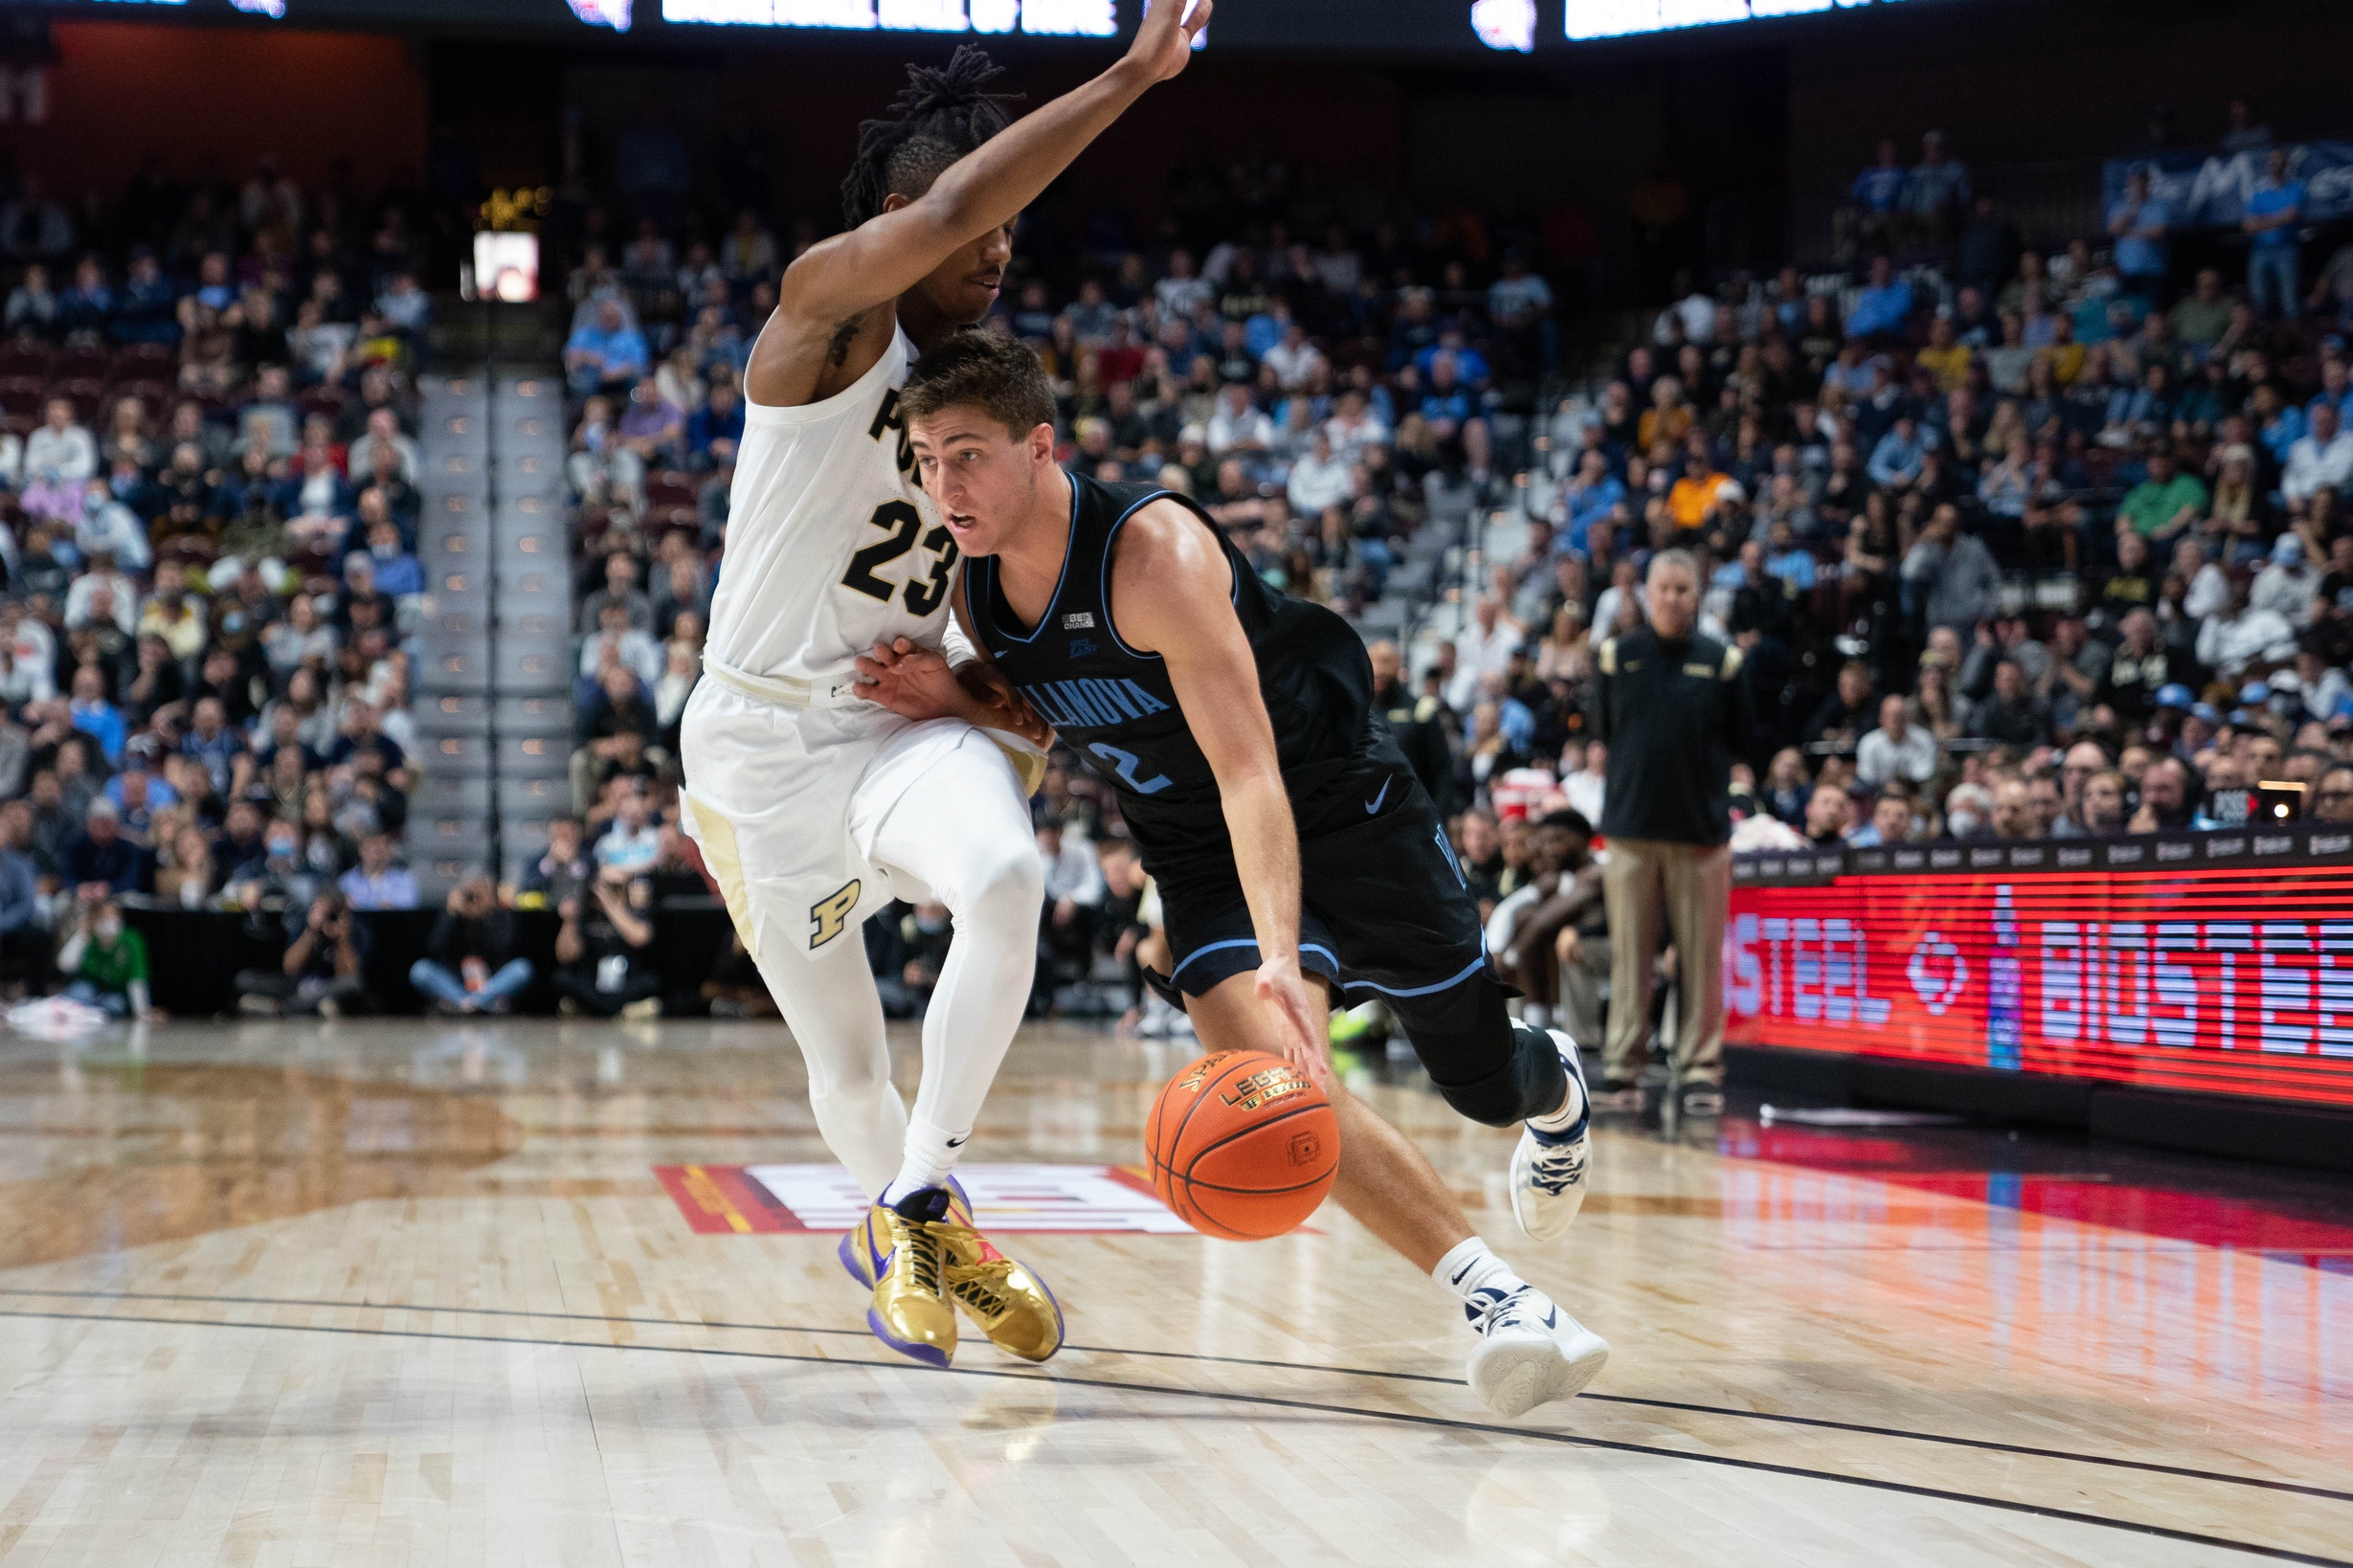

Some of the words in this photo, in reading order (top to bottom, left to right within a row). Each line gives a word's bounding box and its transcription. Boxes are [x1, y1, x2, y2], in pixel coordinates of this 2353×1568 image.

[840, 497, 958, 617] 23
[1087, 742, 1174, 794] 2
[809, 878, 861, 951] P
[1724, 913, 1892, 1024] STEEL
